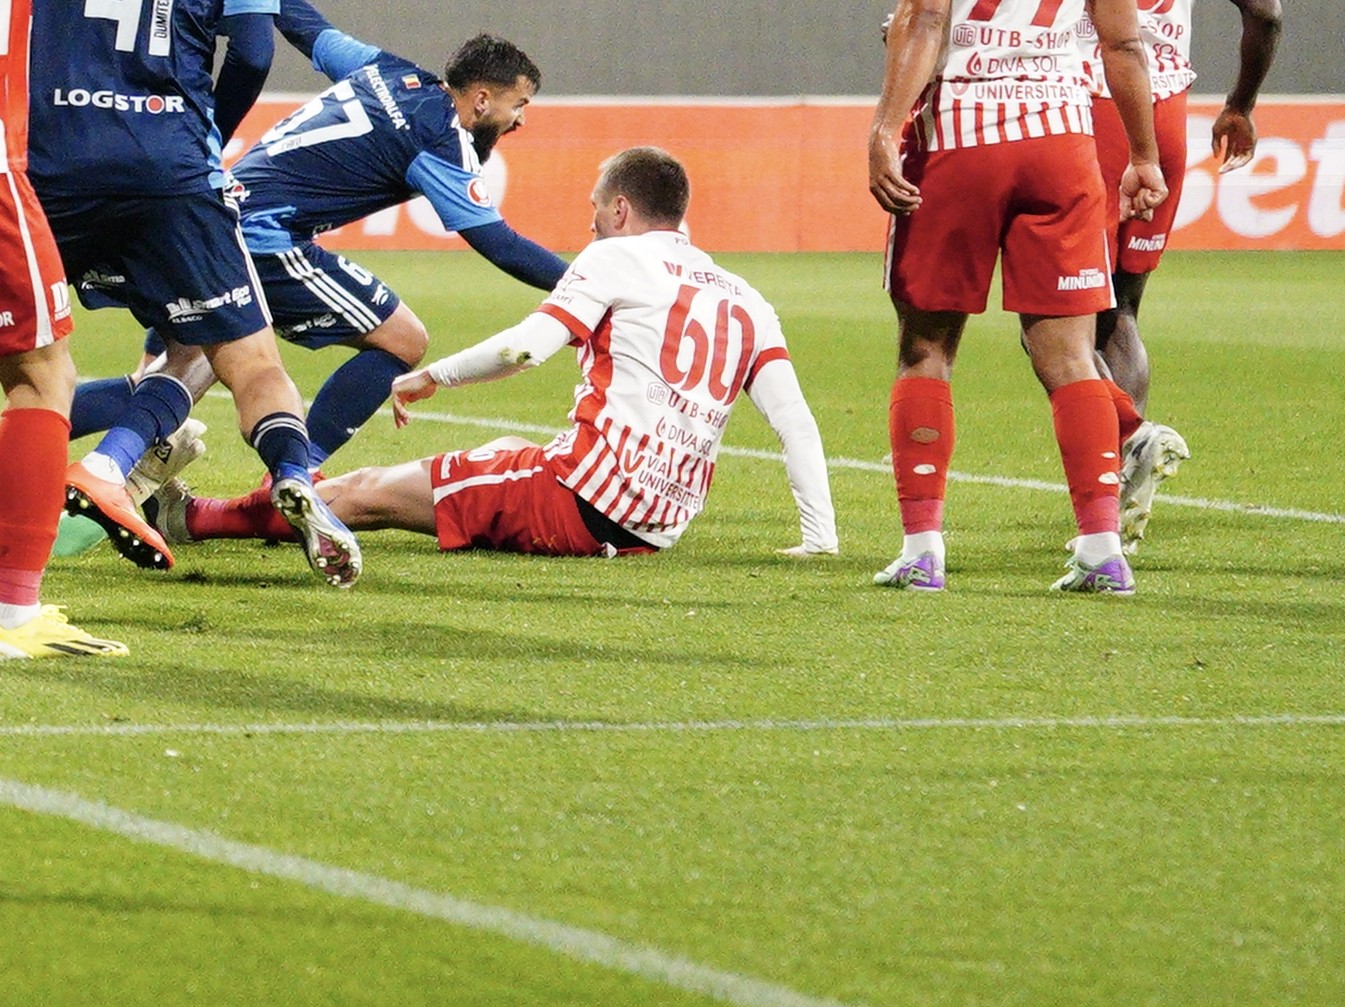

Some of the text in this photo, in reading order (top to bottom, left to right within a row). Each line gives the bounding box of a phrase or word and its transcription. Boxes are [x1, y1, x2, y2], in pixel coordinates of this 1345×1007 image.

[987, 56, 1061, 74] DIVA SOL
[54, 88, 185, 113] LOGSTOR
[659, 284, 755, 406] 60
[667, 424, 698, 451] DIVA
[647, 455, 667, 475] VIA
